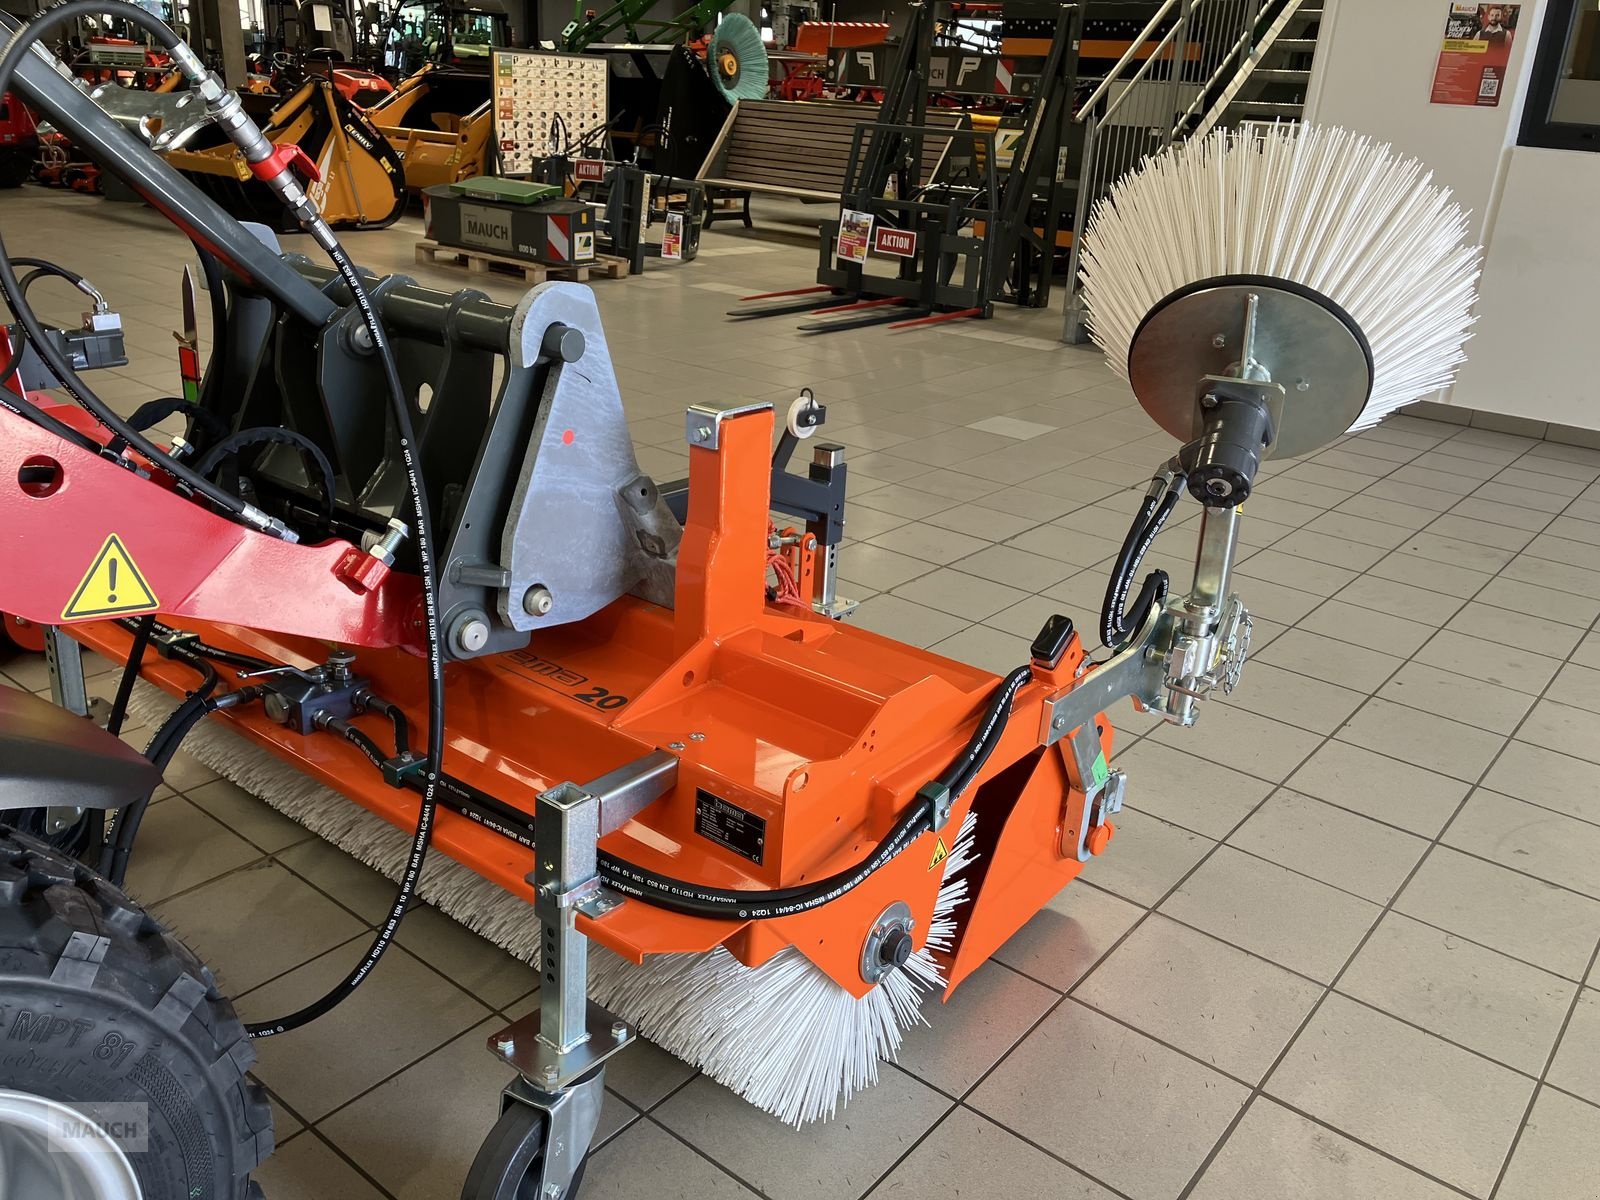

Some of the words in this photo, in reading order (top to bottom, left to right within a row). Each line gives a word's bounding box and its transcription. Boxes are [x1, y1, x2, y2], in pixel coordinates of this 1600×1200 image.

[579, 164, 600, 176] AKTION
[468, 220, 508, 240] MAUCH
[882, 234, 909, 250] AKTION
[530, 246, 536, 256] kg
[343, 265, 352, 276] 853
[349, 275, 358, 286] EN
[356, 289, 369, 309] HD110
[414, 496, 422, 516] MSHA
[422, 551, 428, 562] WP
[428, 606, 435, 616] EN
[429, 618, 437, 640] HD110
[573, 687, 628, 709] 20
[611, 864, 620, 873] WP
[371, 940, 386, 958] HD110
[383, 930, 392, 939] EN
[388, 919, 396, 930] 853
[394, 905, 403, 917] 1SN
[403, 882, 411, 893] WP
[411, 853, 420, 868] BAR
[416, 832, 426, 851] MSHA
[421, 804, 431, 831] IC-84/41
[632, 873, 644, 883] 1SN
[854, 874, 864, 884] WP
[659, 883, 669, 891] EN
[671, 887, 694, 898] HD110
[827, 888, 842, 899] BAR
[804, 897, 825, 908] MSHA
[776, 902, 803, 915] IC-84/41
[7, 1009, 96, 1048] MPT
[92, 1031, 136, 1070] 81
